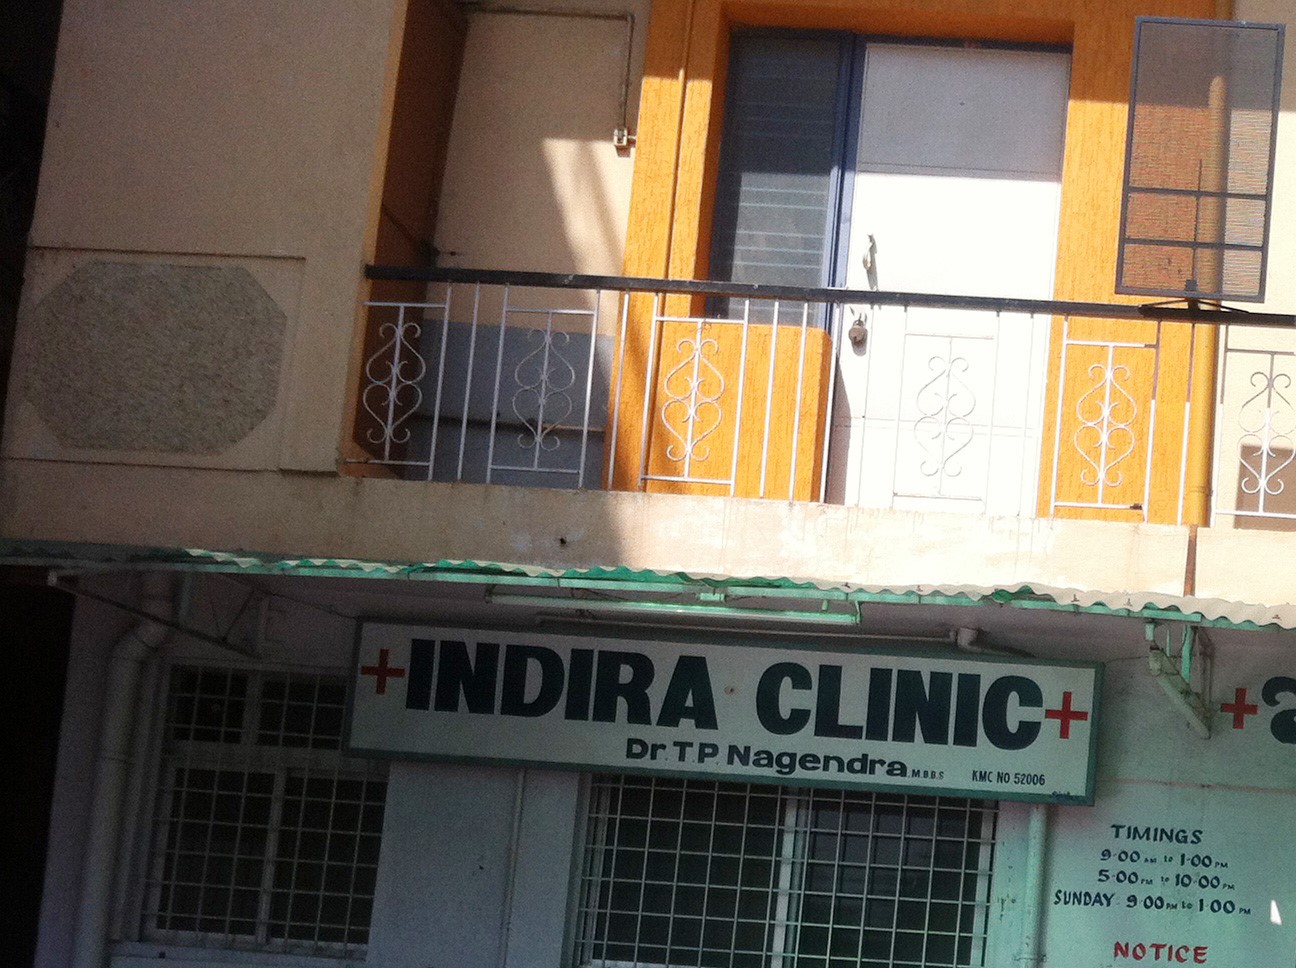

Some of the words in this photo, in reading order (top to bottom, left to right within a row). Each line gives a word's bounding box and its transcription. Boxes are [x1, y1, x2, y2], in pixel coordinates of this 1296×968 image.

[405, 638, 719, 731] INDIRA
[756, 661, 1043, 751] CLINIC
[728, 745, 908, 775] Nagendra
[972, 771, 993, 785] KMC
[1014, 772, 1046, 787] 52006
[1111, 824, 1203, 844] TIMINGS
[1164, 855, 1173, 863] to
[1161, 875, 1170, 884] to
[1053, 889, 1115, 907] SUNDAY
[1182, 901, 1193, 909] to
[1239, 907, 1251, 915] PM
[1113, 941, 1208, 964] NOTICE
